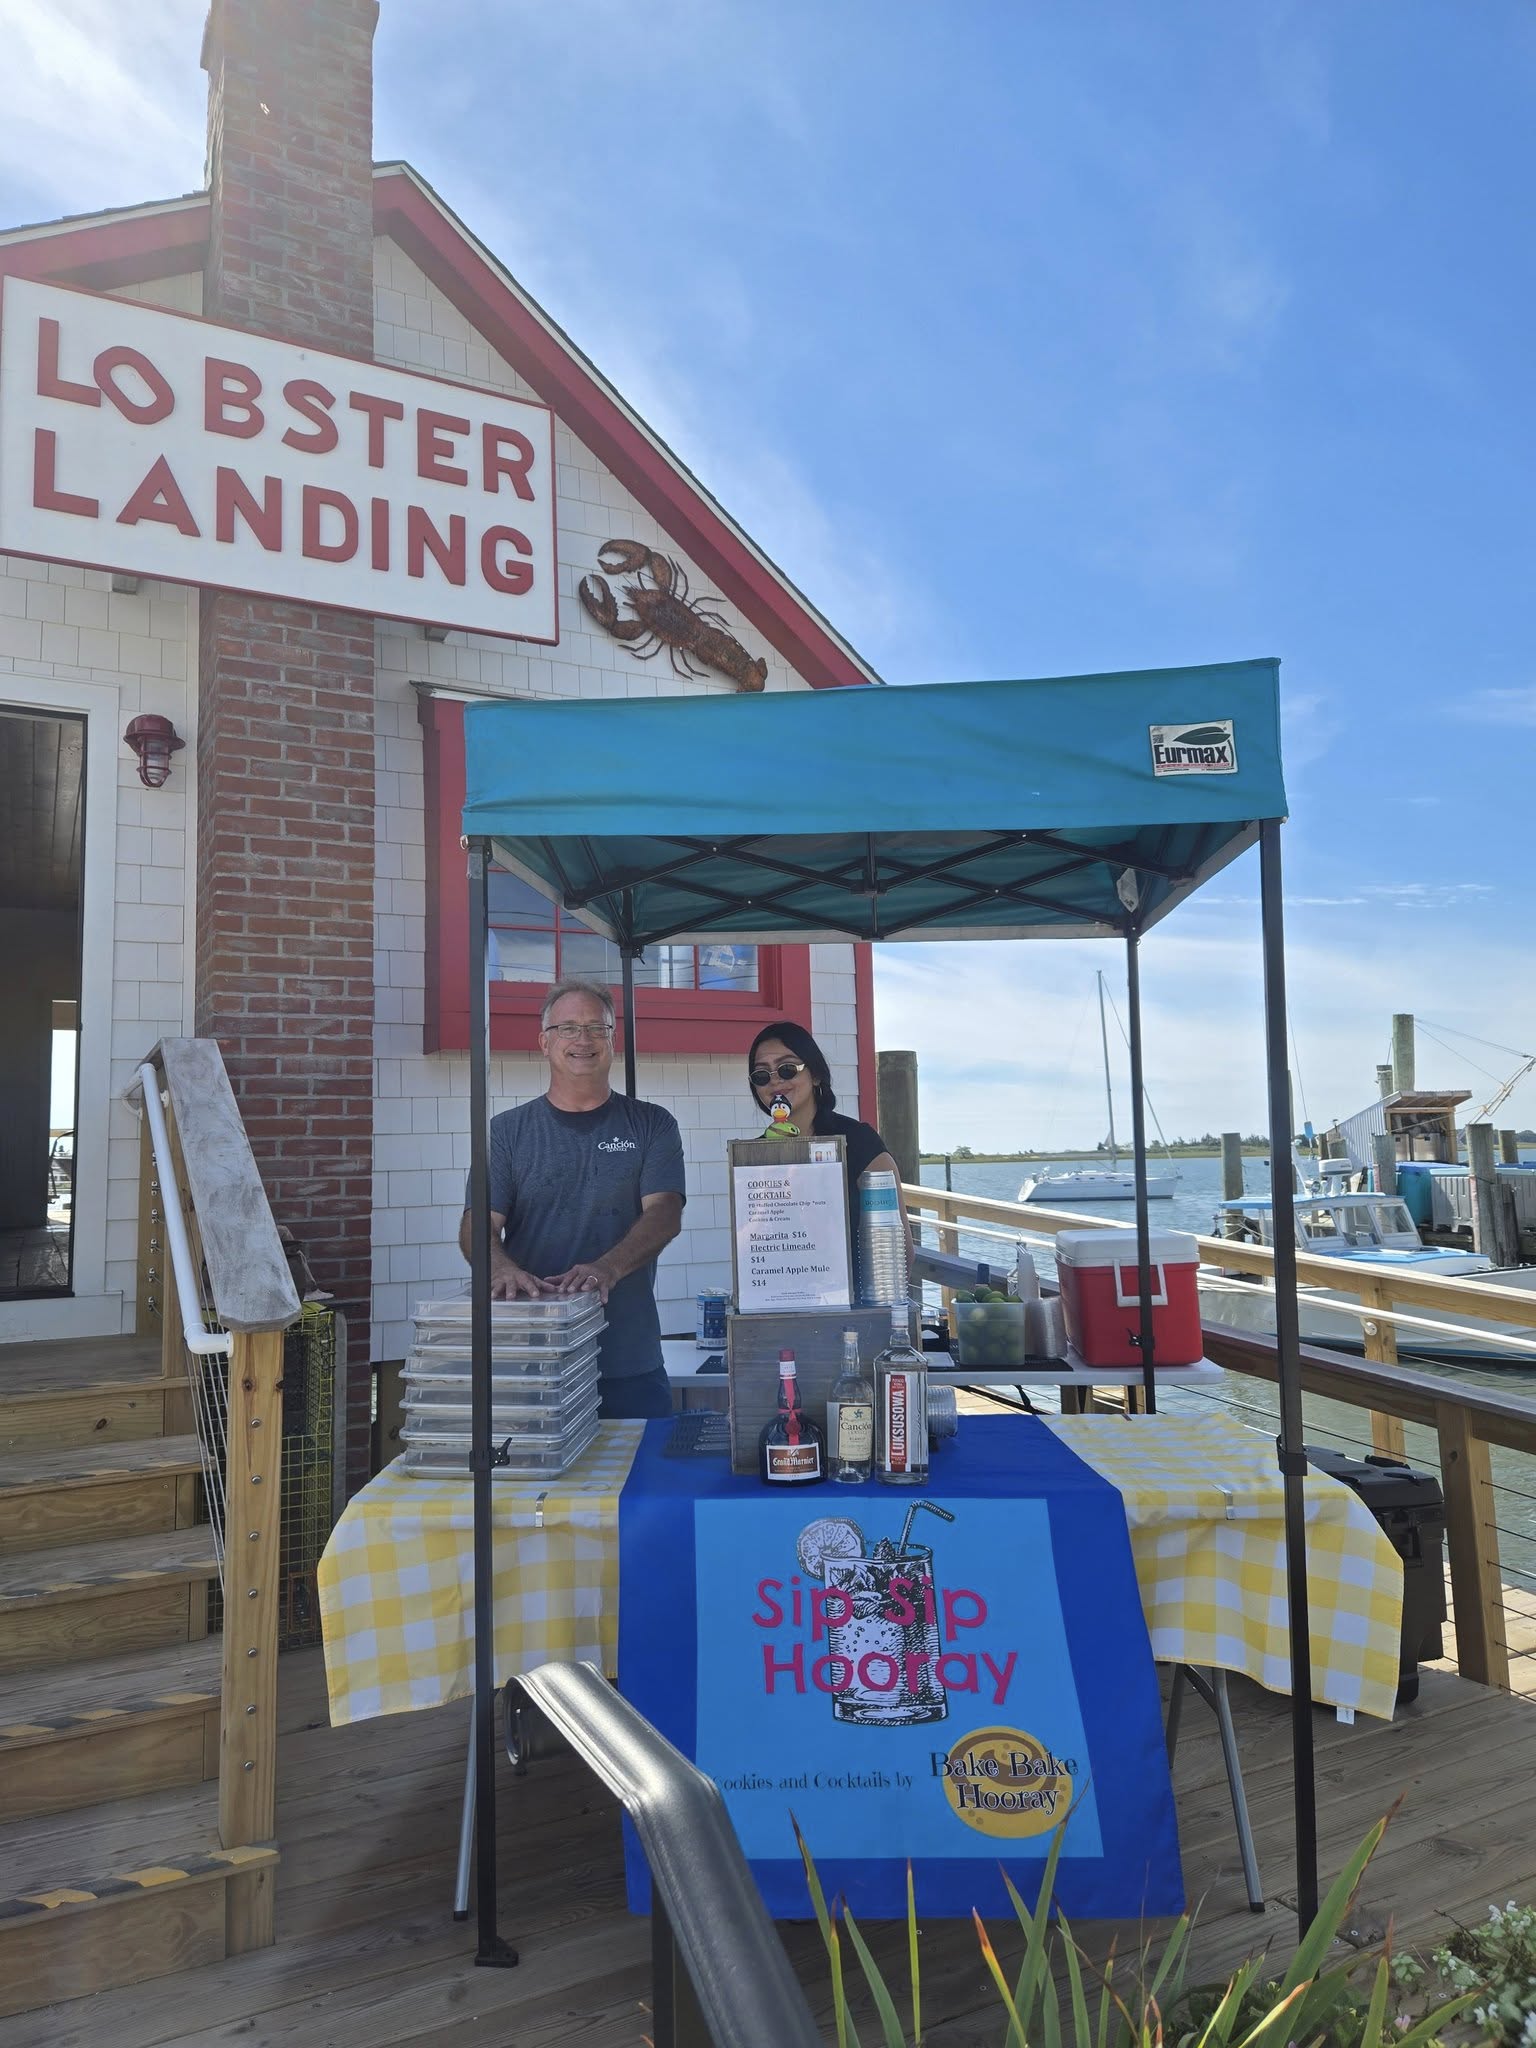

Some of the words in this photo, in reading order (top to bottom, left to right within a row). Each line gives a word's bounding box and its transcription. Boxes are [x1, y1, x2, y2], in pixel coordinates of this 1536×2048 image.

[37, 317, 535, 501] LOBSTER
[33, 427, 534, 595] LANDING
[1154, 744, 1229, 764] Eurmax
[748, 1180, 782, 1189] COOKIES
[784, 1179, 790, 1187] &
[748, 1191, 792, 1200] COCKTAILS
[750, 1232, 789, 1241] Margarita
[792, 1231, 807, 1239] $16
[750, 1244, 780, 1252] Electric
[782, 1242, 816, 1251] Limeade
[750, 1256, 765, 1264] $14
[751, 1267, 784, 1275] Caramel
[786, 1266, 809, 1275] Apple
[810, 1265, 830, 1273] Mule
[752, 1279, 766, 1287] $14
[892, 1390, 904, 1456] LUKSUSOWA
[752, 1576, 854, 1642] Sip
[884, 1576, 987, 1642] Sip
[763, 1643, 1018, 1705] Hooray
[929, 1751, 1000, 1778] Bake
[1008, 1751, 1079, 1778] Bake
[779, 1773, 808, 1789] and
[814, 1771, 890, 1789] Cocktails
[896, 1771, 913, 1789] by
[956, 1782, 1060, 1816] Hooray
